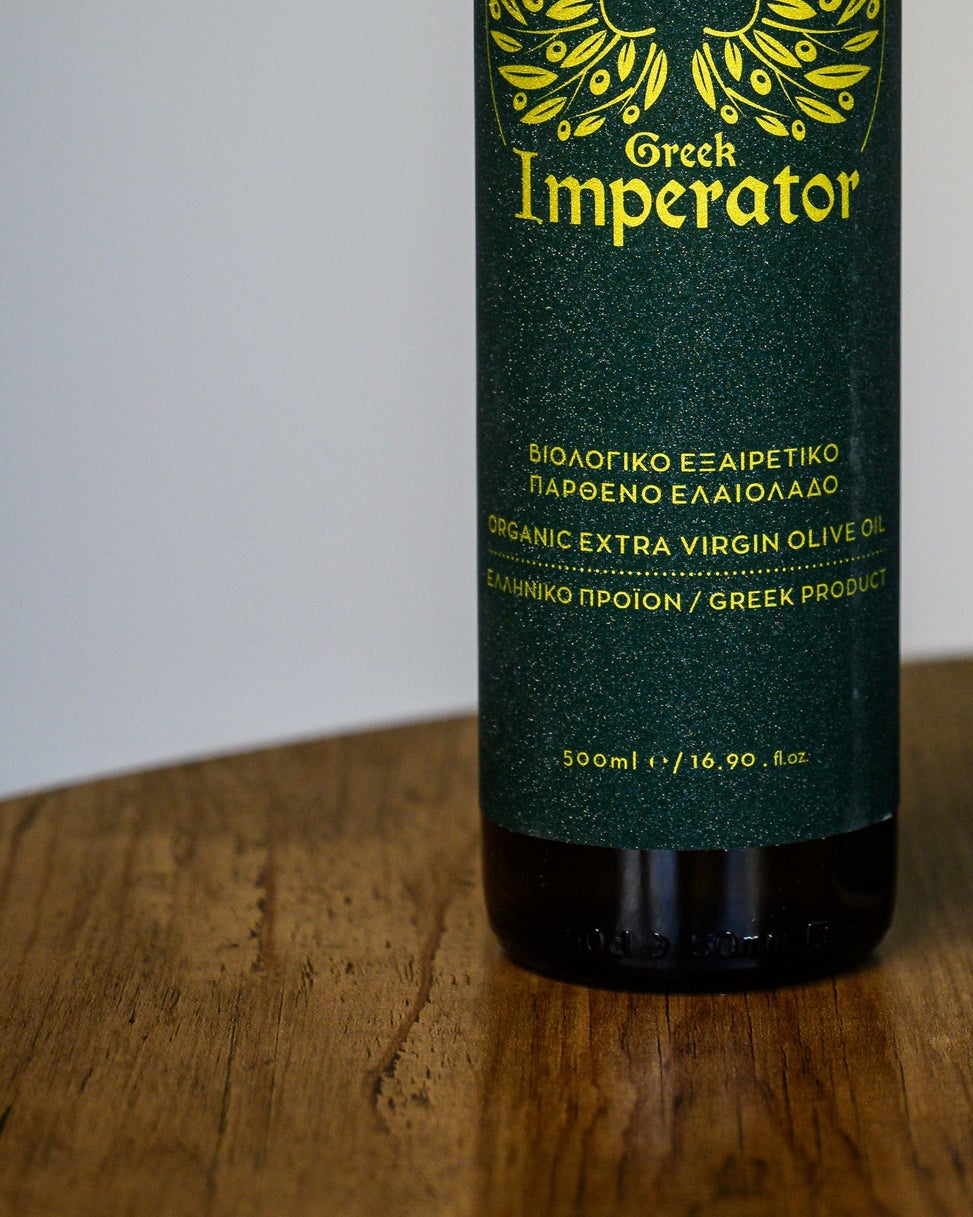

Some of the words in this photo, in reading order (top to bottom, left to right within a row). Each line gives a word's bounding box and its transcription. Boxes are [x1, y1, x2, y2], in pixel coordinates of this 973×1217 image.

[624, 131, 737, 169] Greek
[512, 147, 861, 248] Imperator
[529, 442, 672, 473] ΒΙΟΛΟΓΙΚΟ
[679, 442, 839, 473] ΕΞΑΙΡΕΤΙΚΟ
[529, 474, 663, 505] ΠΑΡΘΕΝΟ
[671, 474, 839, 505] ΕΛΑΙΟΛΑΔΟ
[488, 514, 572, 550] ORGANIC
[579, 531, 672, 557] EXTRA
[679, 532, 779, 556] VIRGIN
[787, 522, 855, 551] OLIVE
[861, 515, 885, 538] OIL
[487, 568, 573, 605] ΕΛΛΗΝΙΚΟ
[708, 587, 794, 611] GREEK
[801, 568, 886, 604] PRODUCT
[563, 749, 638, 770] 500ml
